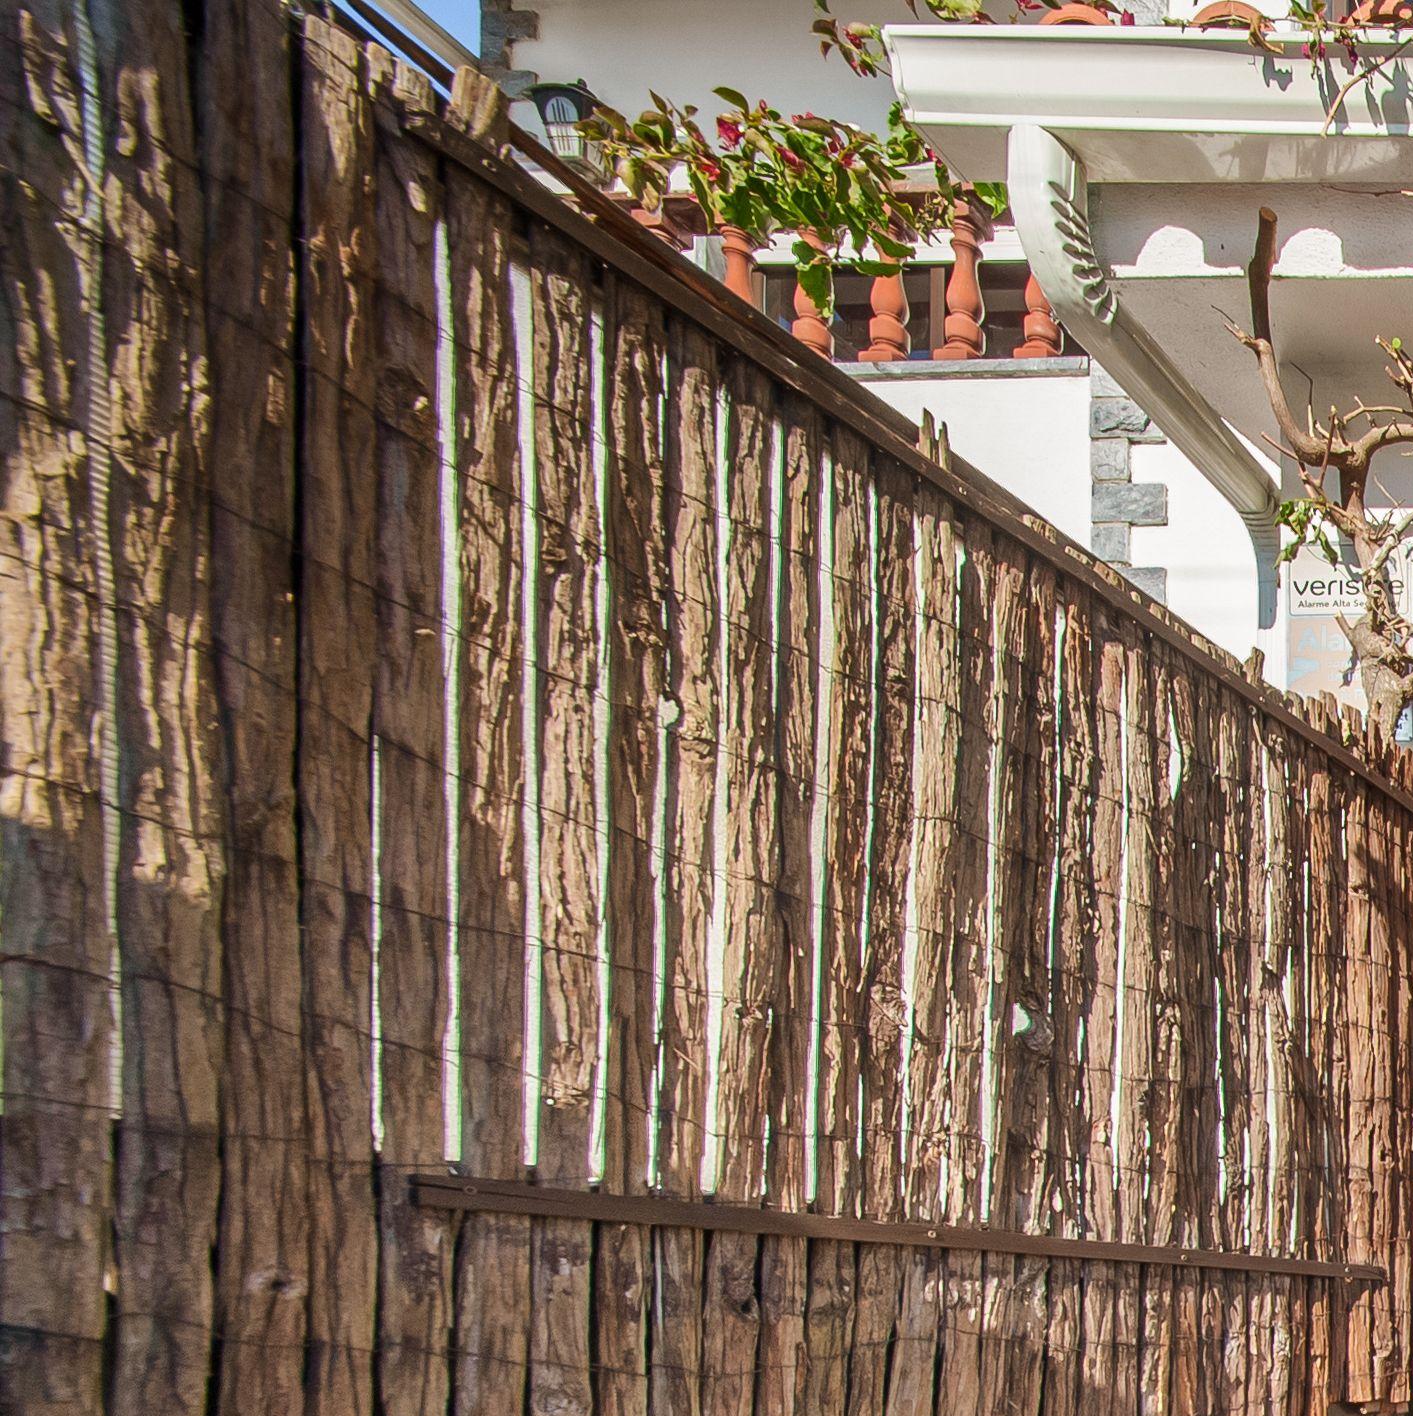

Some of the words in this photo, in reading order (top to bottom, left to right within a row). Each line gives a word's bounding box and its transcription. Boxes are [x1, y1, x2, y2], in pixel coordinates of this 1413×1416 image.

[1293, 579, 1405, 596] verise
[1297, 600, 1330, 609] Alarme
[1332, 600, 1351, 608] Alta
